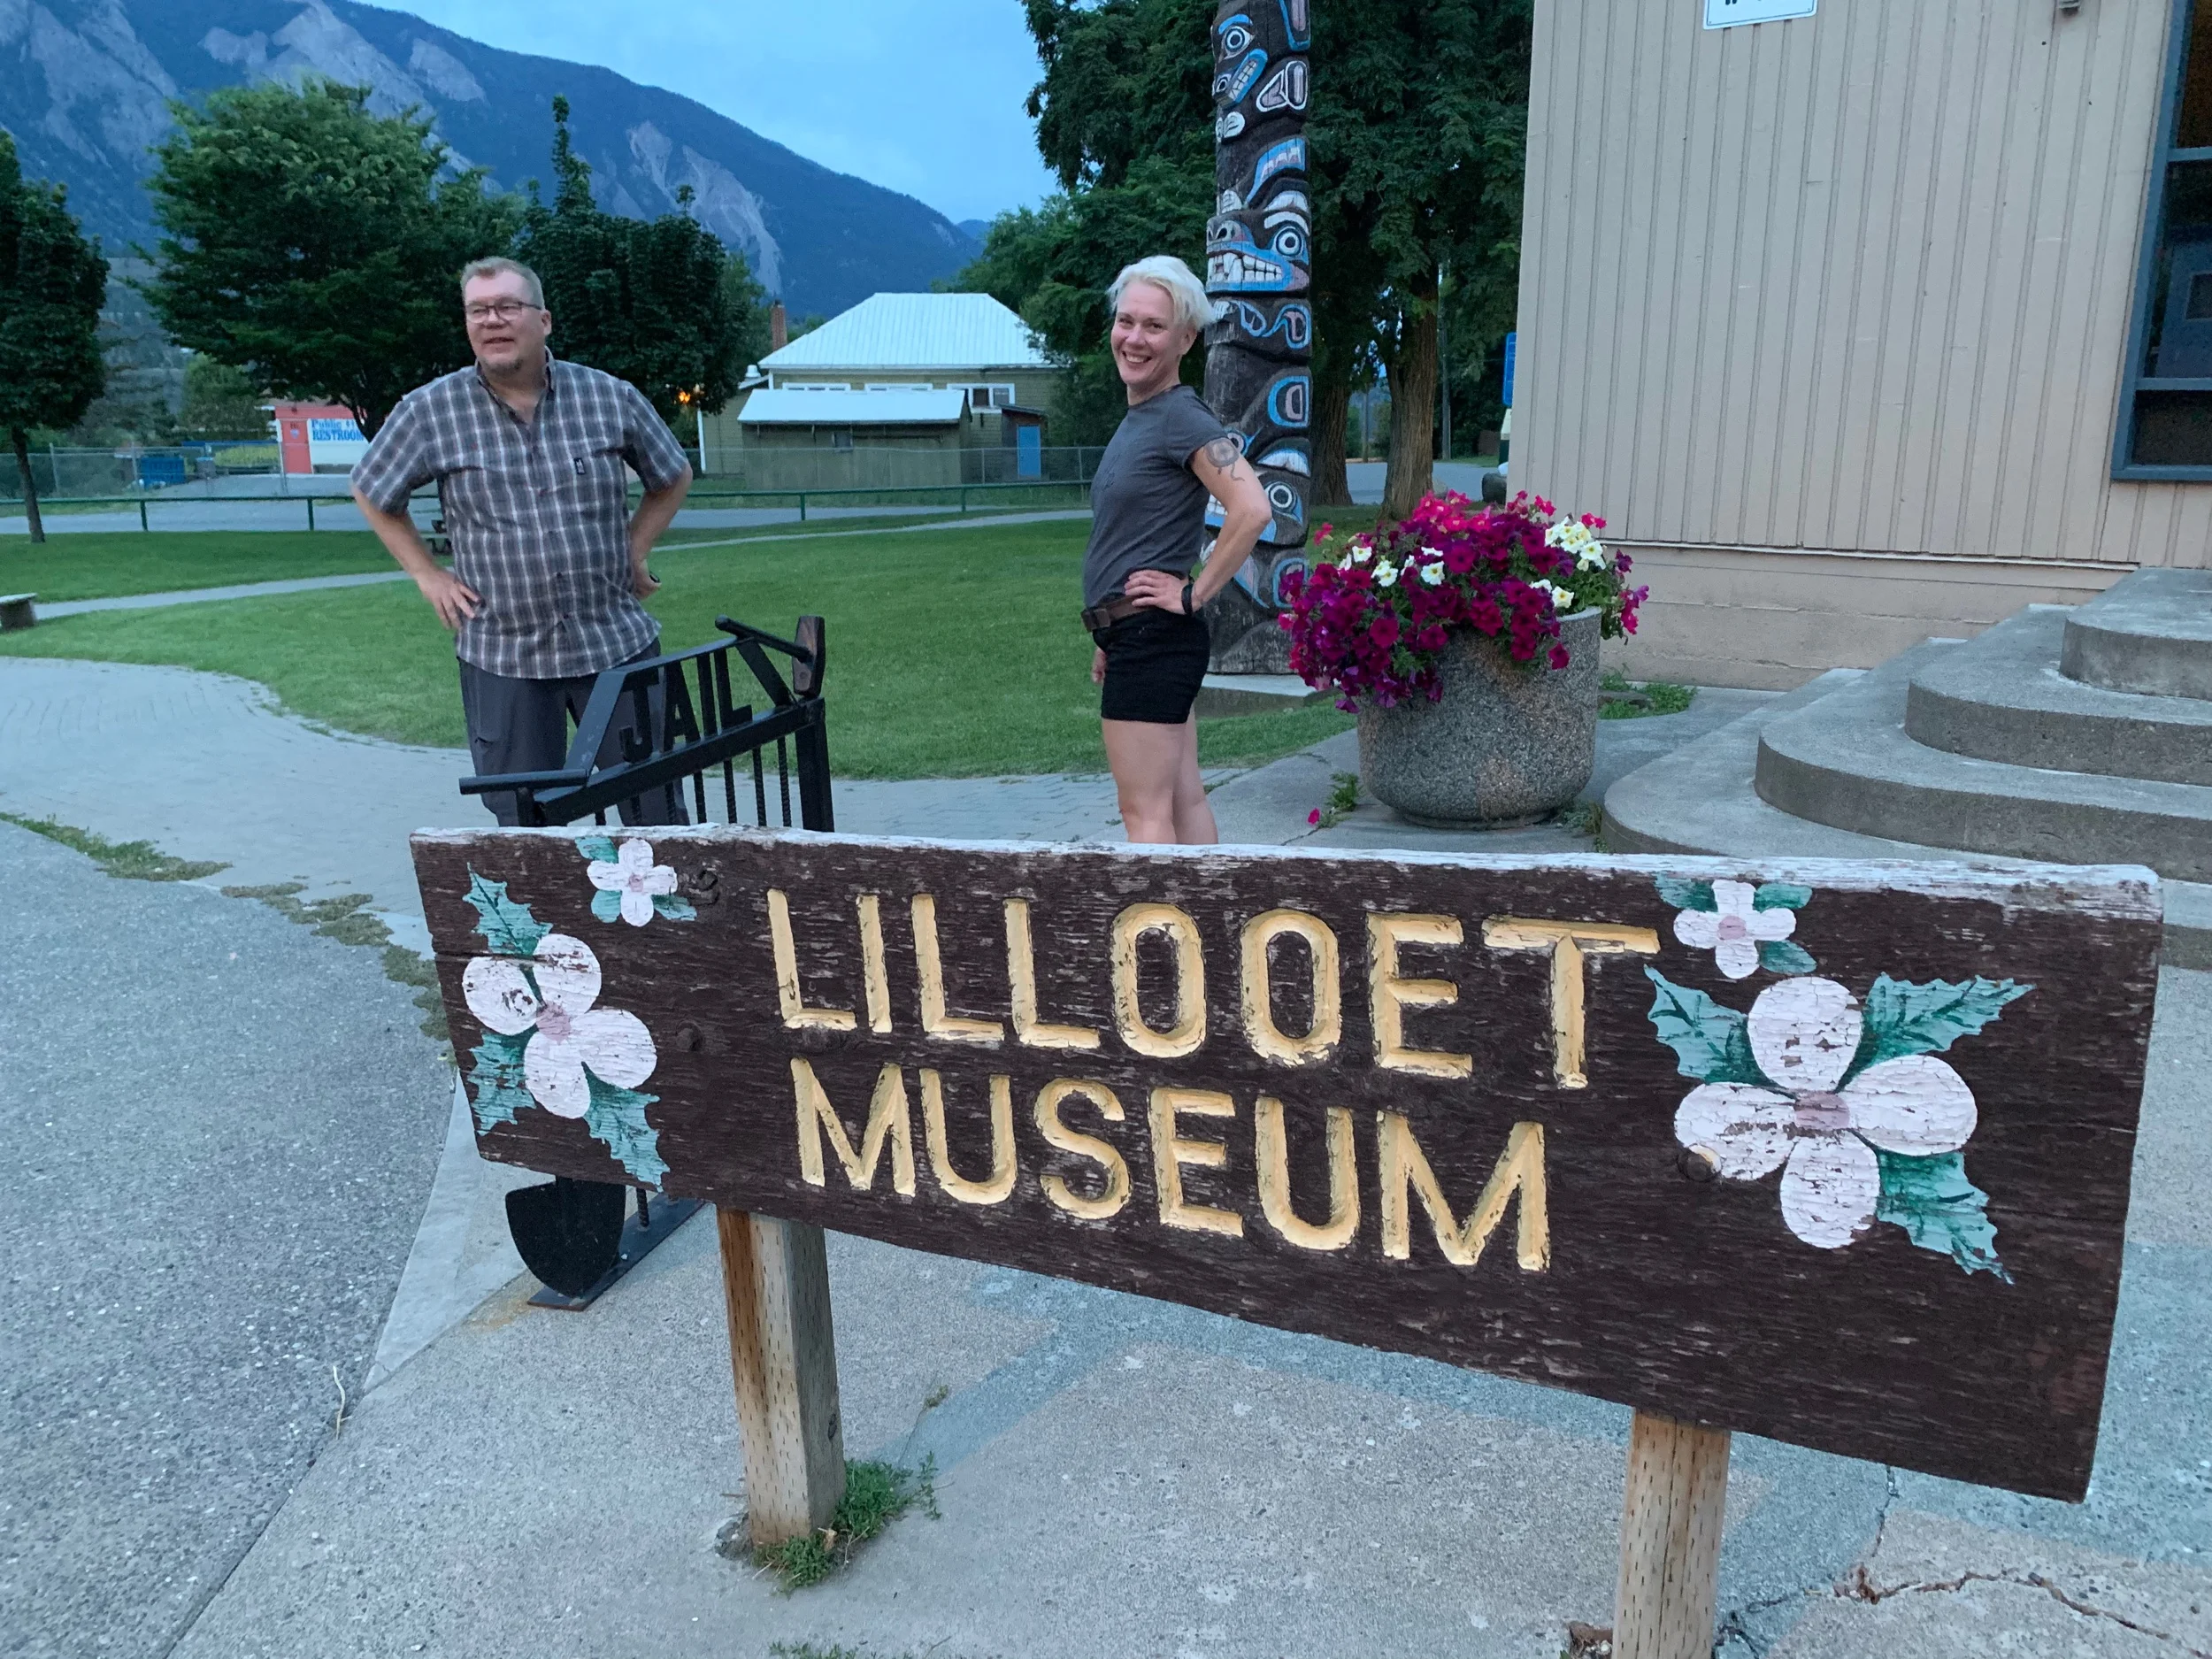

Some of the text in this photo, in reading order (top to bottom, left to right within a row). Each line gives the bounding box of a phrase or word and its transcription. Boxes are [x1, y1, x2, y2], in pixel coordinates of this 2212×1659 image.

[619, 649, 753, 764] JAIL
[767, 888, 1661, 1090] LILLOOET
[790, 1056, 1551, 1271] MUSEUM
